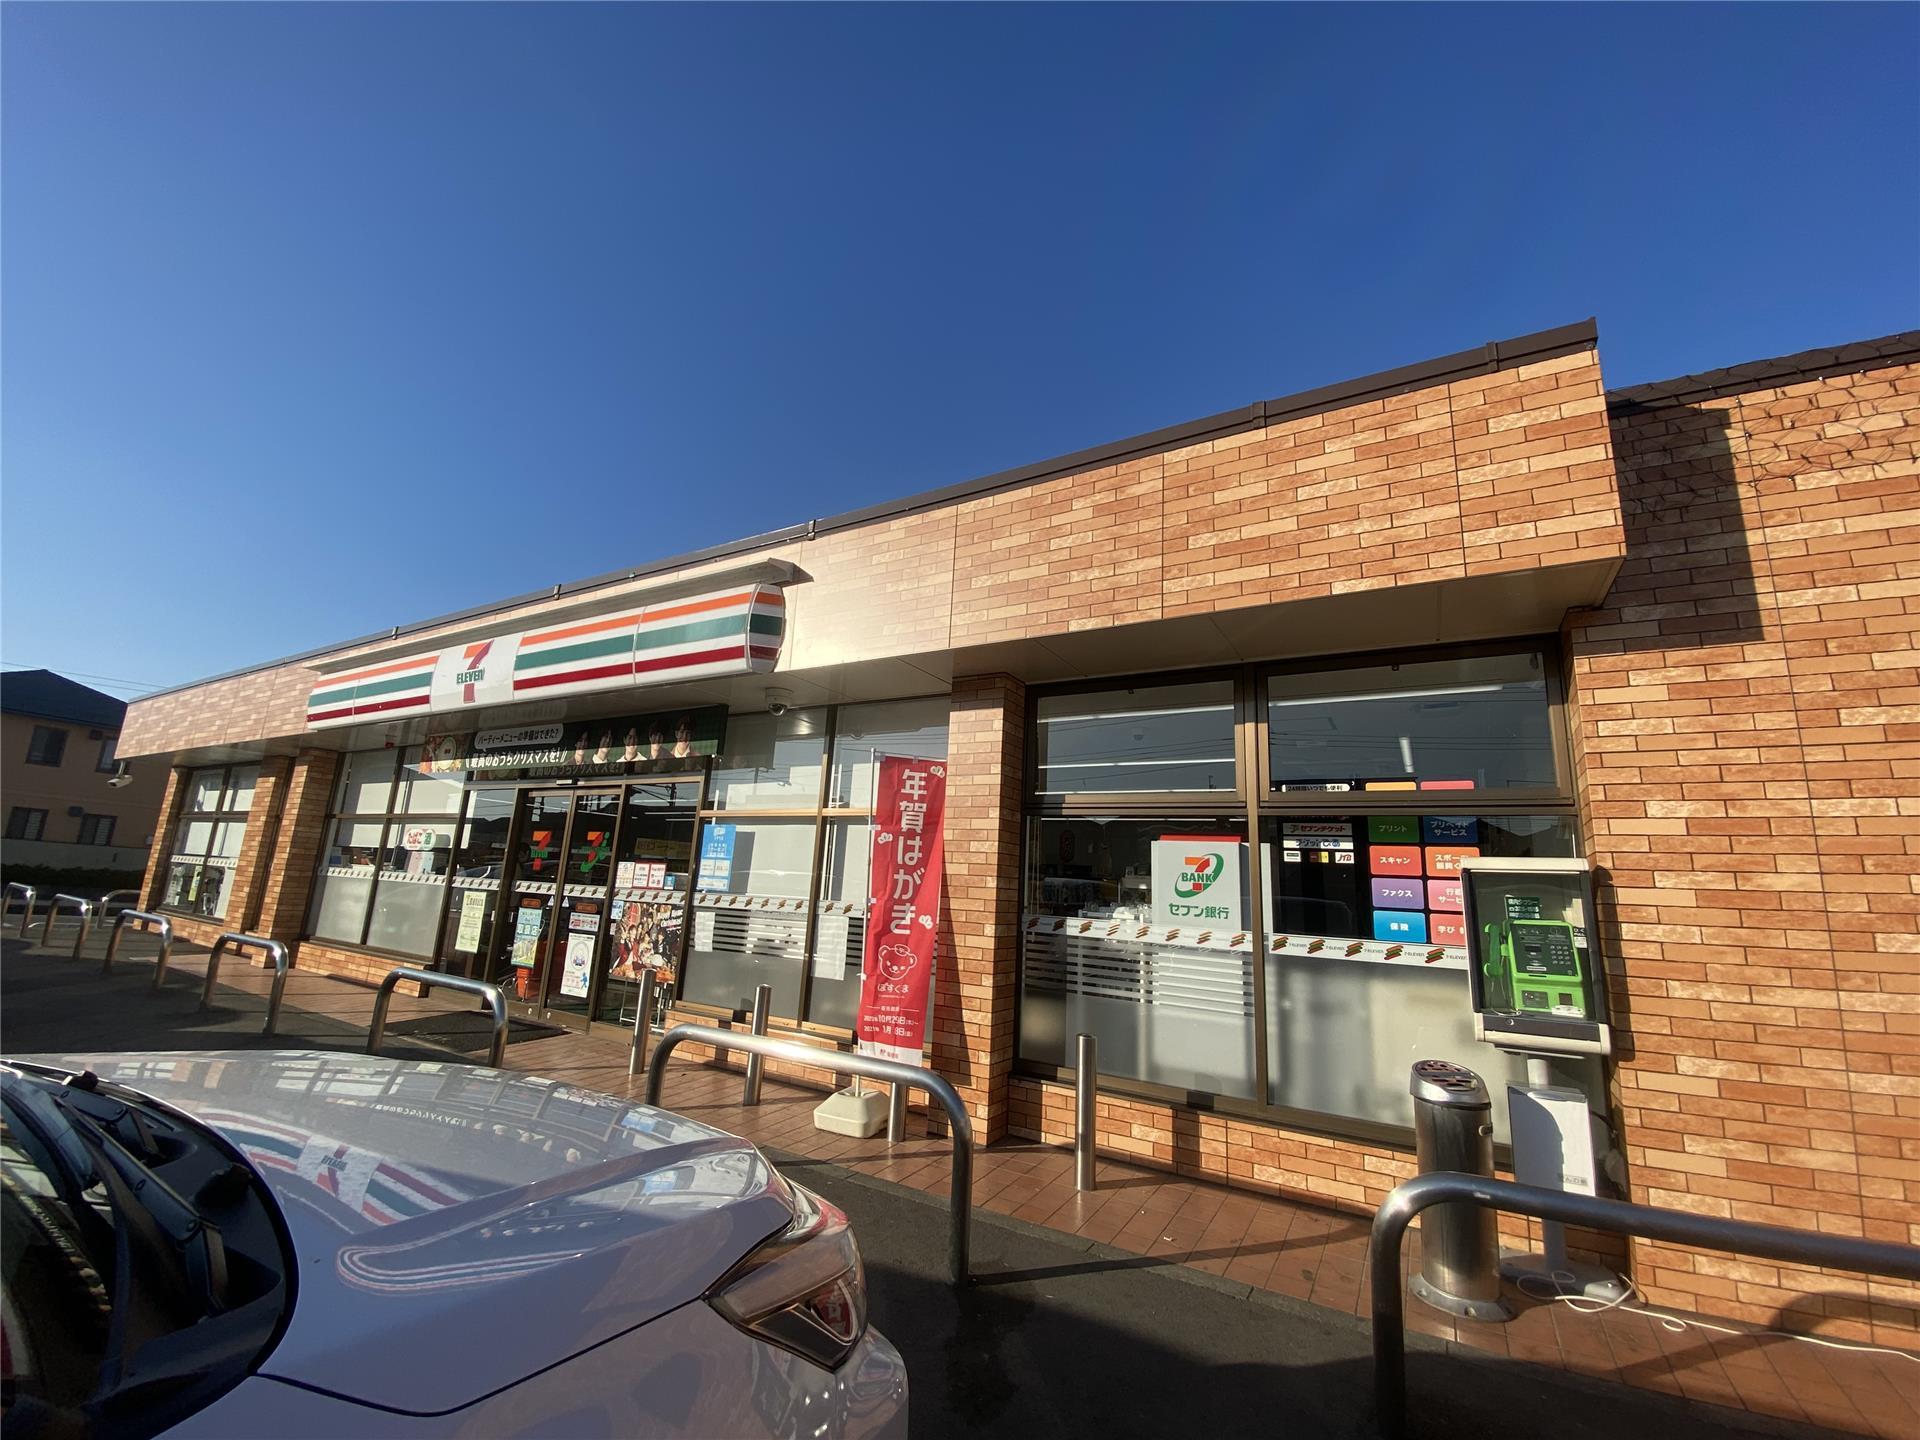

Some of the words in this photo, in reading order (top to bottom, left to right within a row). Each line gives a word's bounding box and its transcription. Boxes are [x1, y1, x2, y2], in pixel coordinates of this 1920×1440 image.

[889, 768, 929, 935] 年賀はがき
[1337, 854, 1352, 862] JTB
[1181, 872, 1215, 883] BANK
[1382, 889, 1413, 897] ファクス
[1168, 902, 1230, 920] セブン銀行
